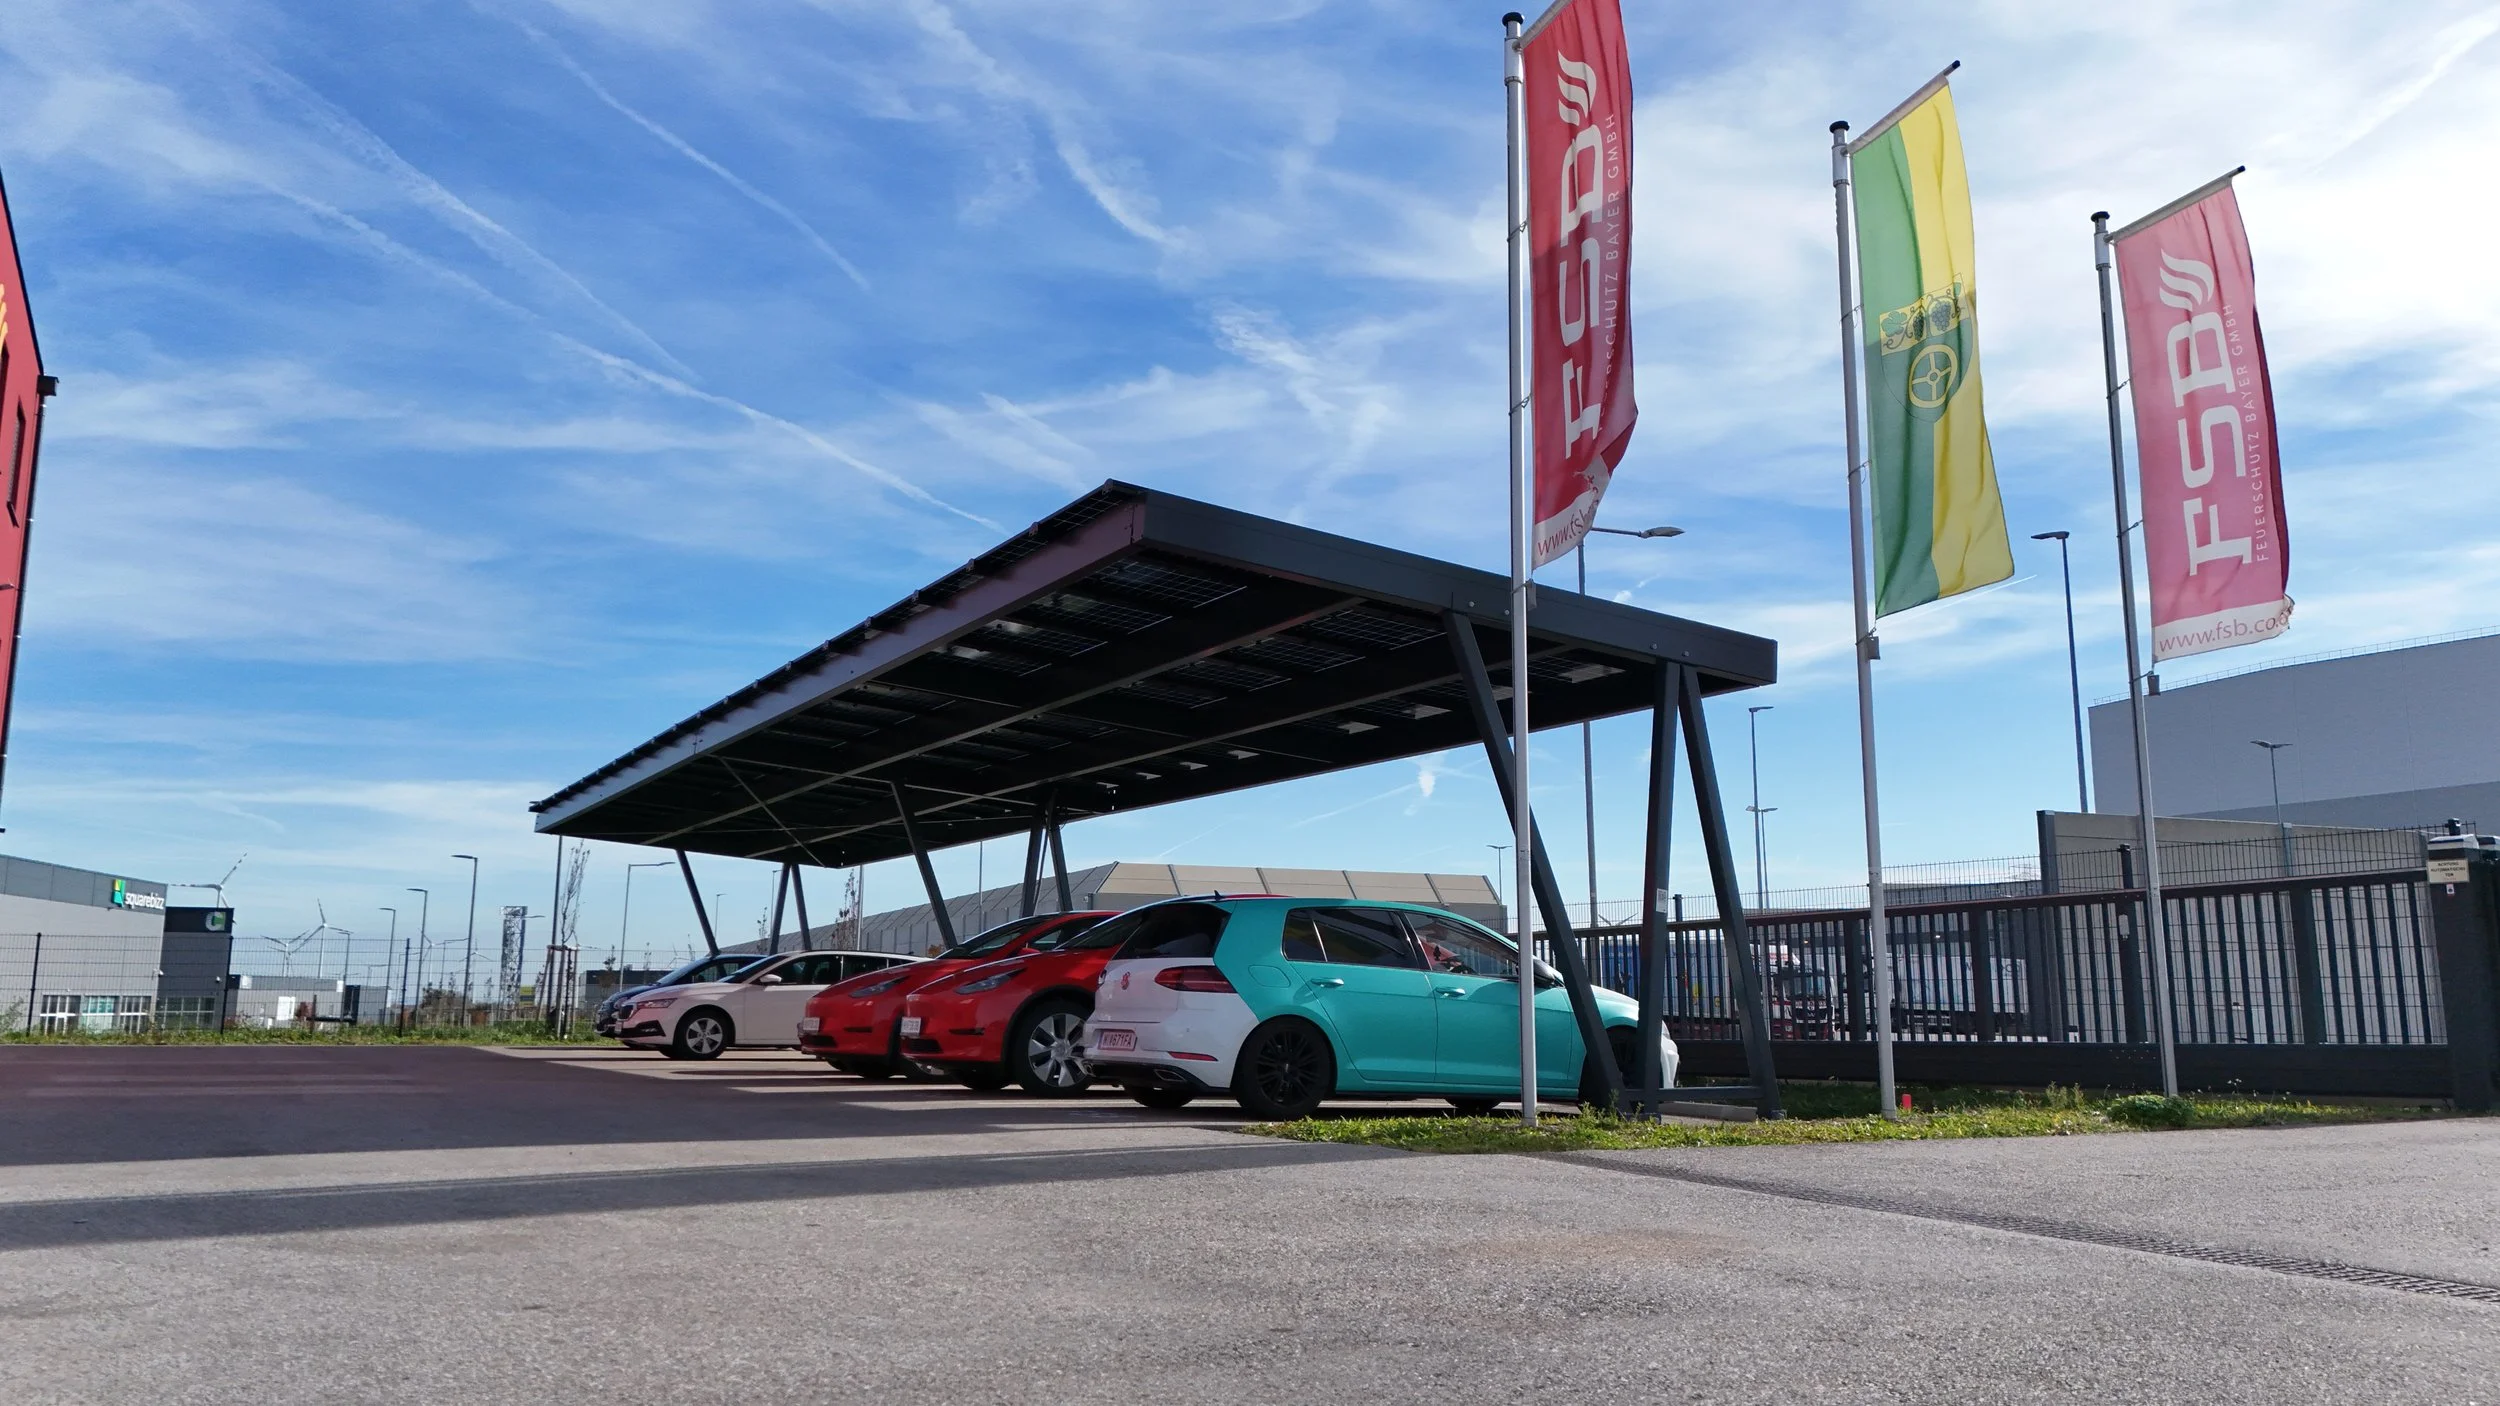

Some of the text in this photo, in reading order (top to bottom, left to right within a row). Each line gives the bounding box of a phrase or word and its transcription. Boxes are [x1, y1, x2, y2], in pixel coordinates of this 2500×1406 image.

[1605, 114, 1619, 178] GMBH
[1605, 191, 1619, 261] BAYER
[1558, 124, 1603, 459] FSB
[2167, 312, 2252, 576] FSB
[2223, 304, 2268, 562] FEUERSCHUTZ BAYER GMBH
[125, 892, 165, 910] squarebizz
